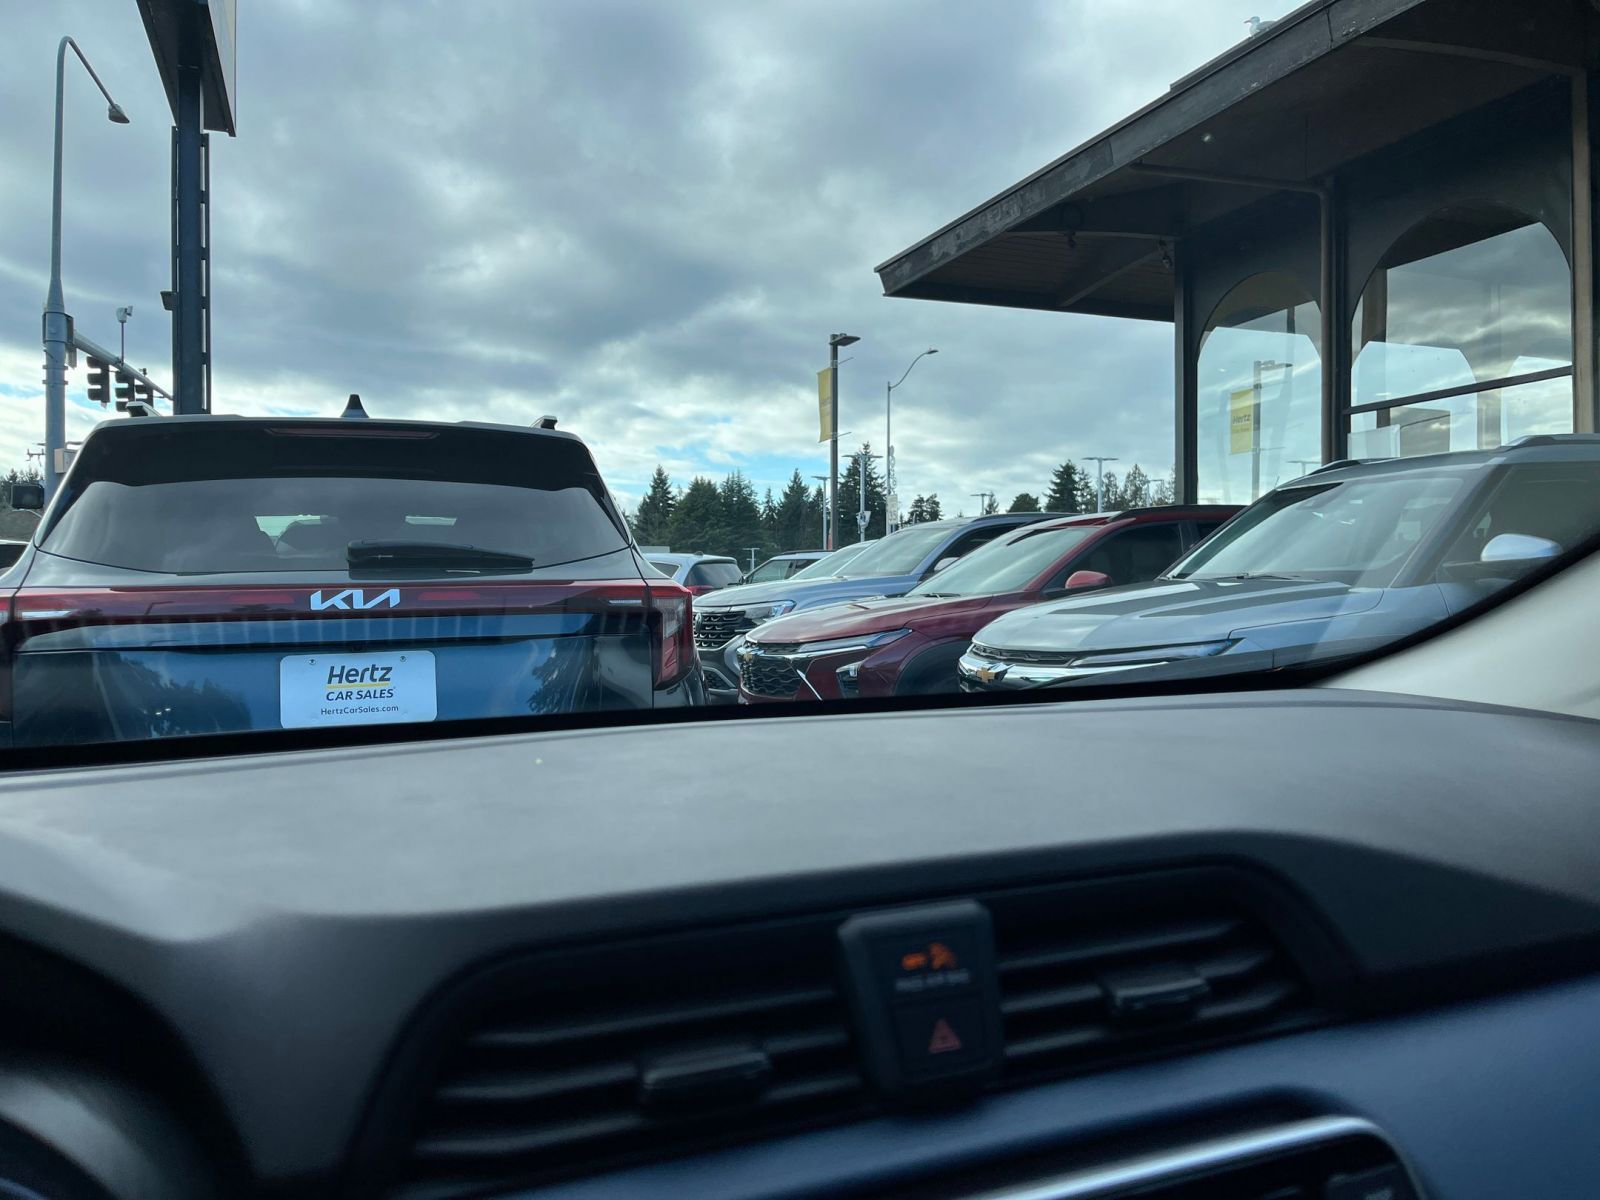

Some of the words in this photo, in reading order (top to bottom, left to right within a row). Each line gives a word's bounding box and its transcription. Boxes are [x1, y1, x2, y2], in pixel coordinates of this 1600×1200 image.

[310, 588, 400, 611] KIA
[327, 663, 393, 685] Hertz
[326, 691, 353, 702] CAR
[355, 688, 394, 701] SALES
[320, 705, 399, 716] HertzCarSales.com
